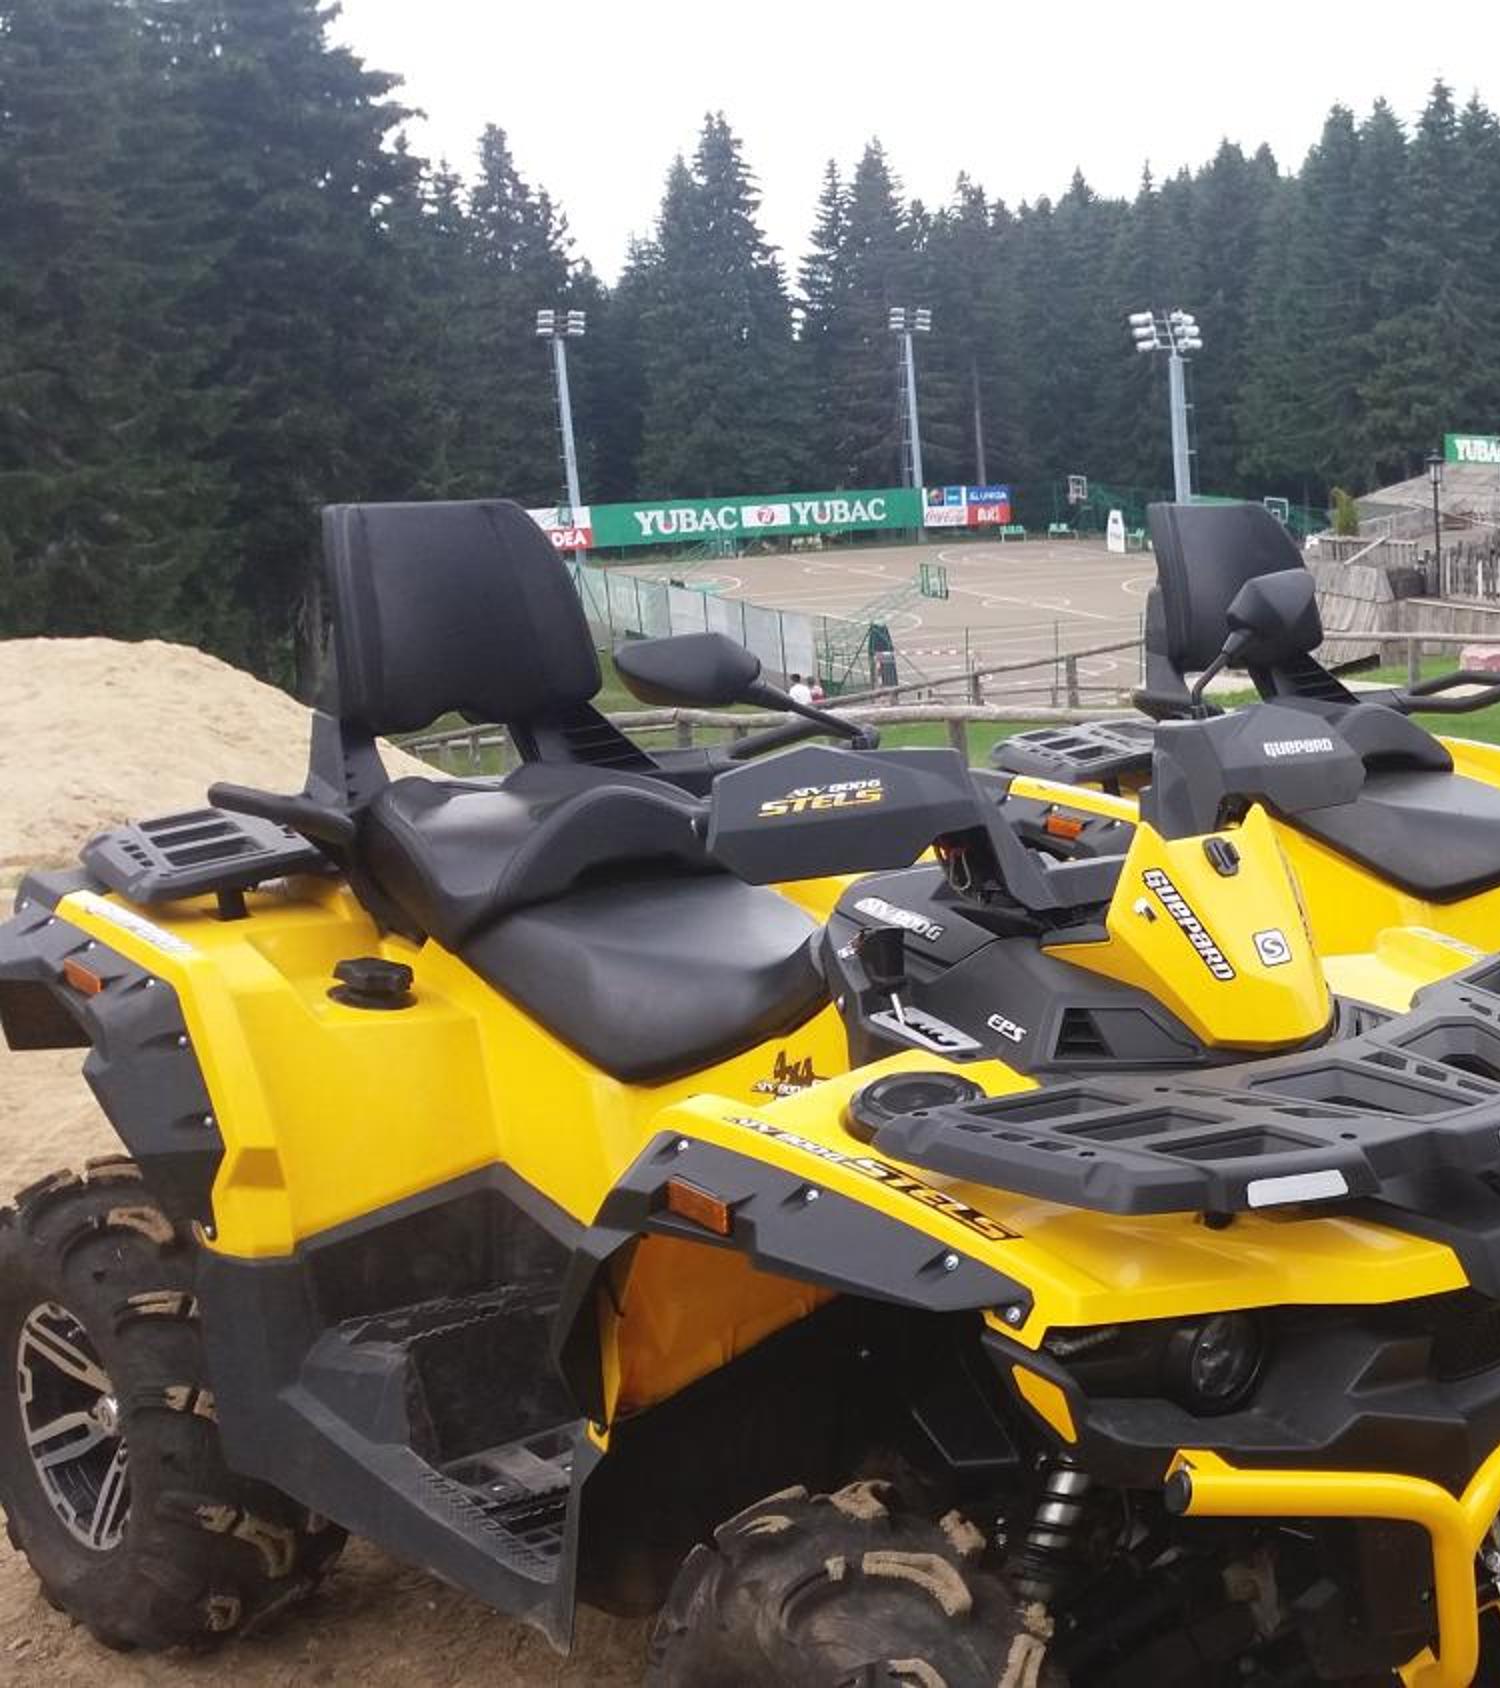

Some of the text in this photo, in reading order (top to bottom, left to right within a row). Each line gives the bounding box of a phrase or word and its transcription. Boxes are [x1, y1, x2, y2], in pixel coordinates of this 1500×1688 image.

[633, 506, 739, 536] YUBAC
[792, 498, 887, 525] YUBAC
[757, 788, 884, 817] STELS
[1142, 867, 1237, 981] GUEPARD
[986, 1013, 1027, 1042] EPS
[846, 1157, 1023, 1240] STELS
